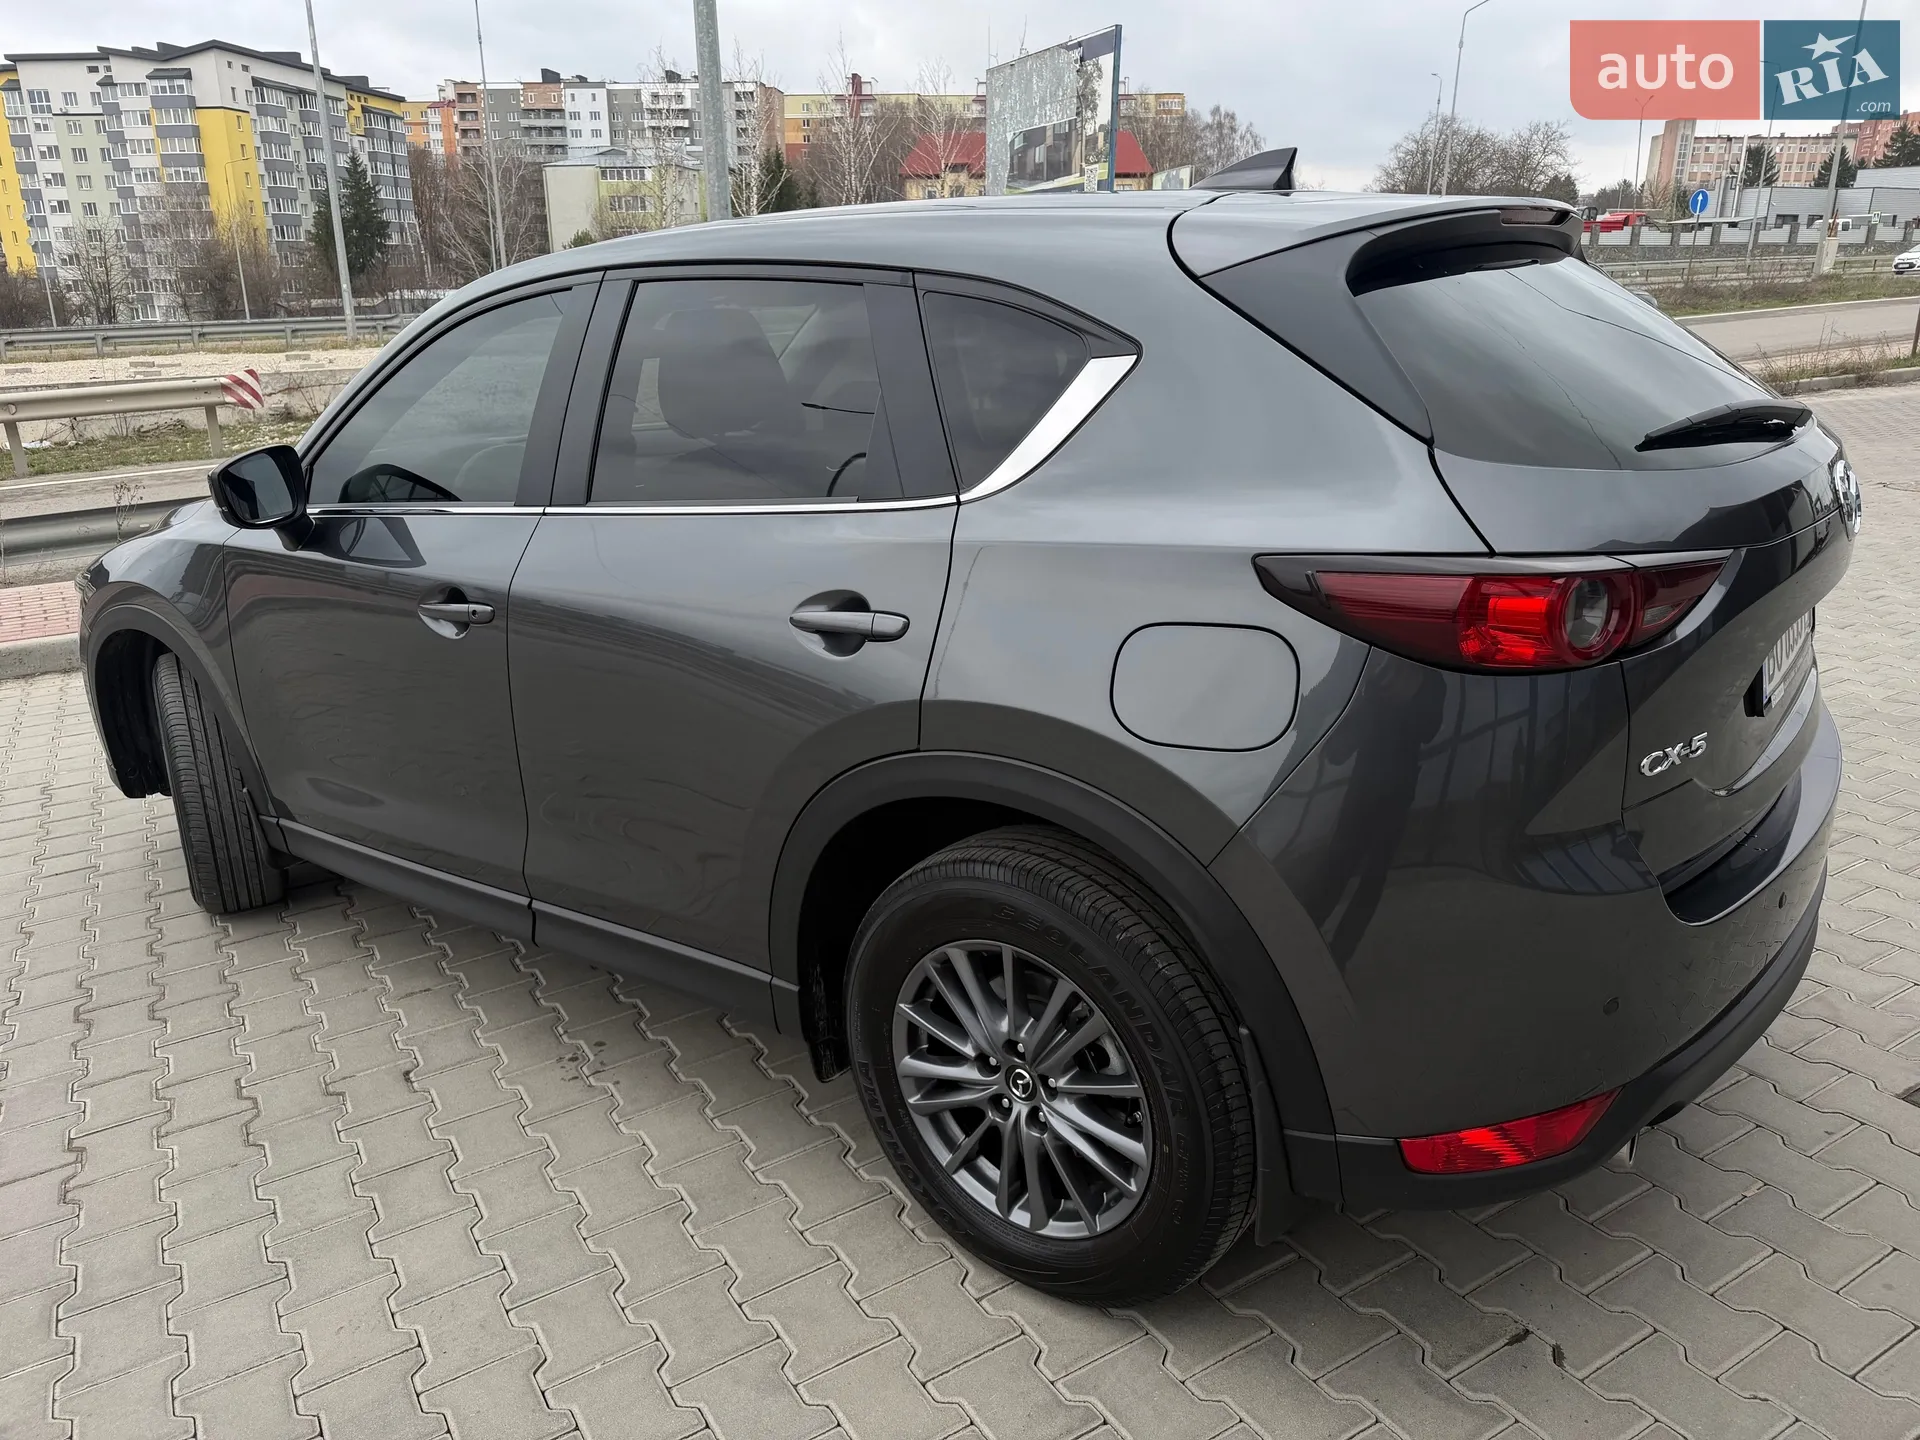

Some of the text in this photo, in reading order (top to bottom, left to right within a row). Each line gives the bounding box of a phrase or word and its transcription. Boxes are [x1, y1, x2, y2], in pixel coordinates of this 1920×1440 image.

[1640, 731, 1708, 777] CX-5
[992, 902, 1188, 1120] GEOLANDAR
[857, 1059, 975, 1244] YOKOHAMA
